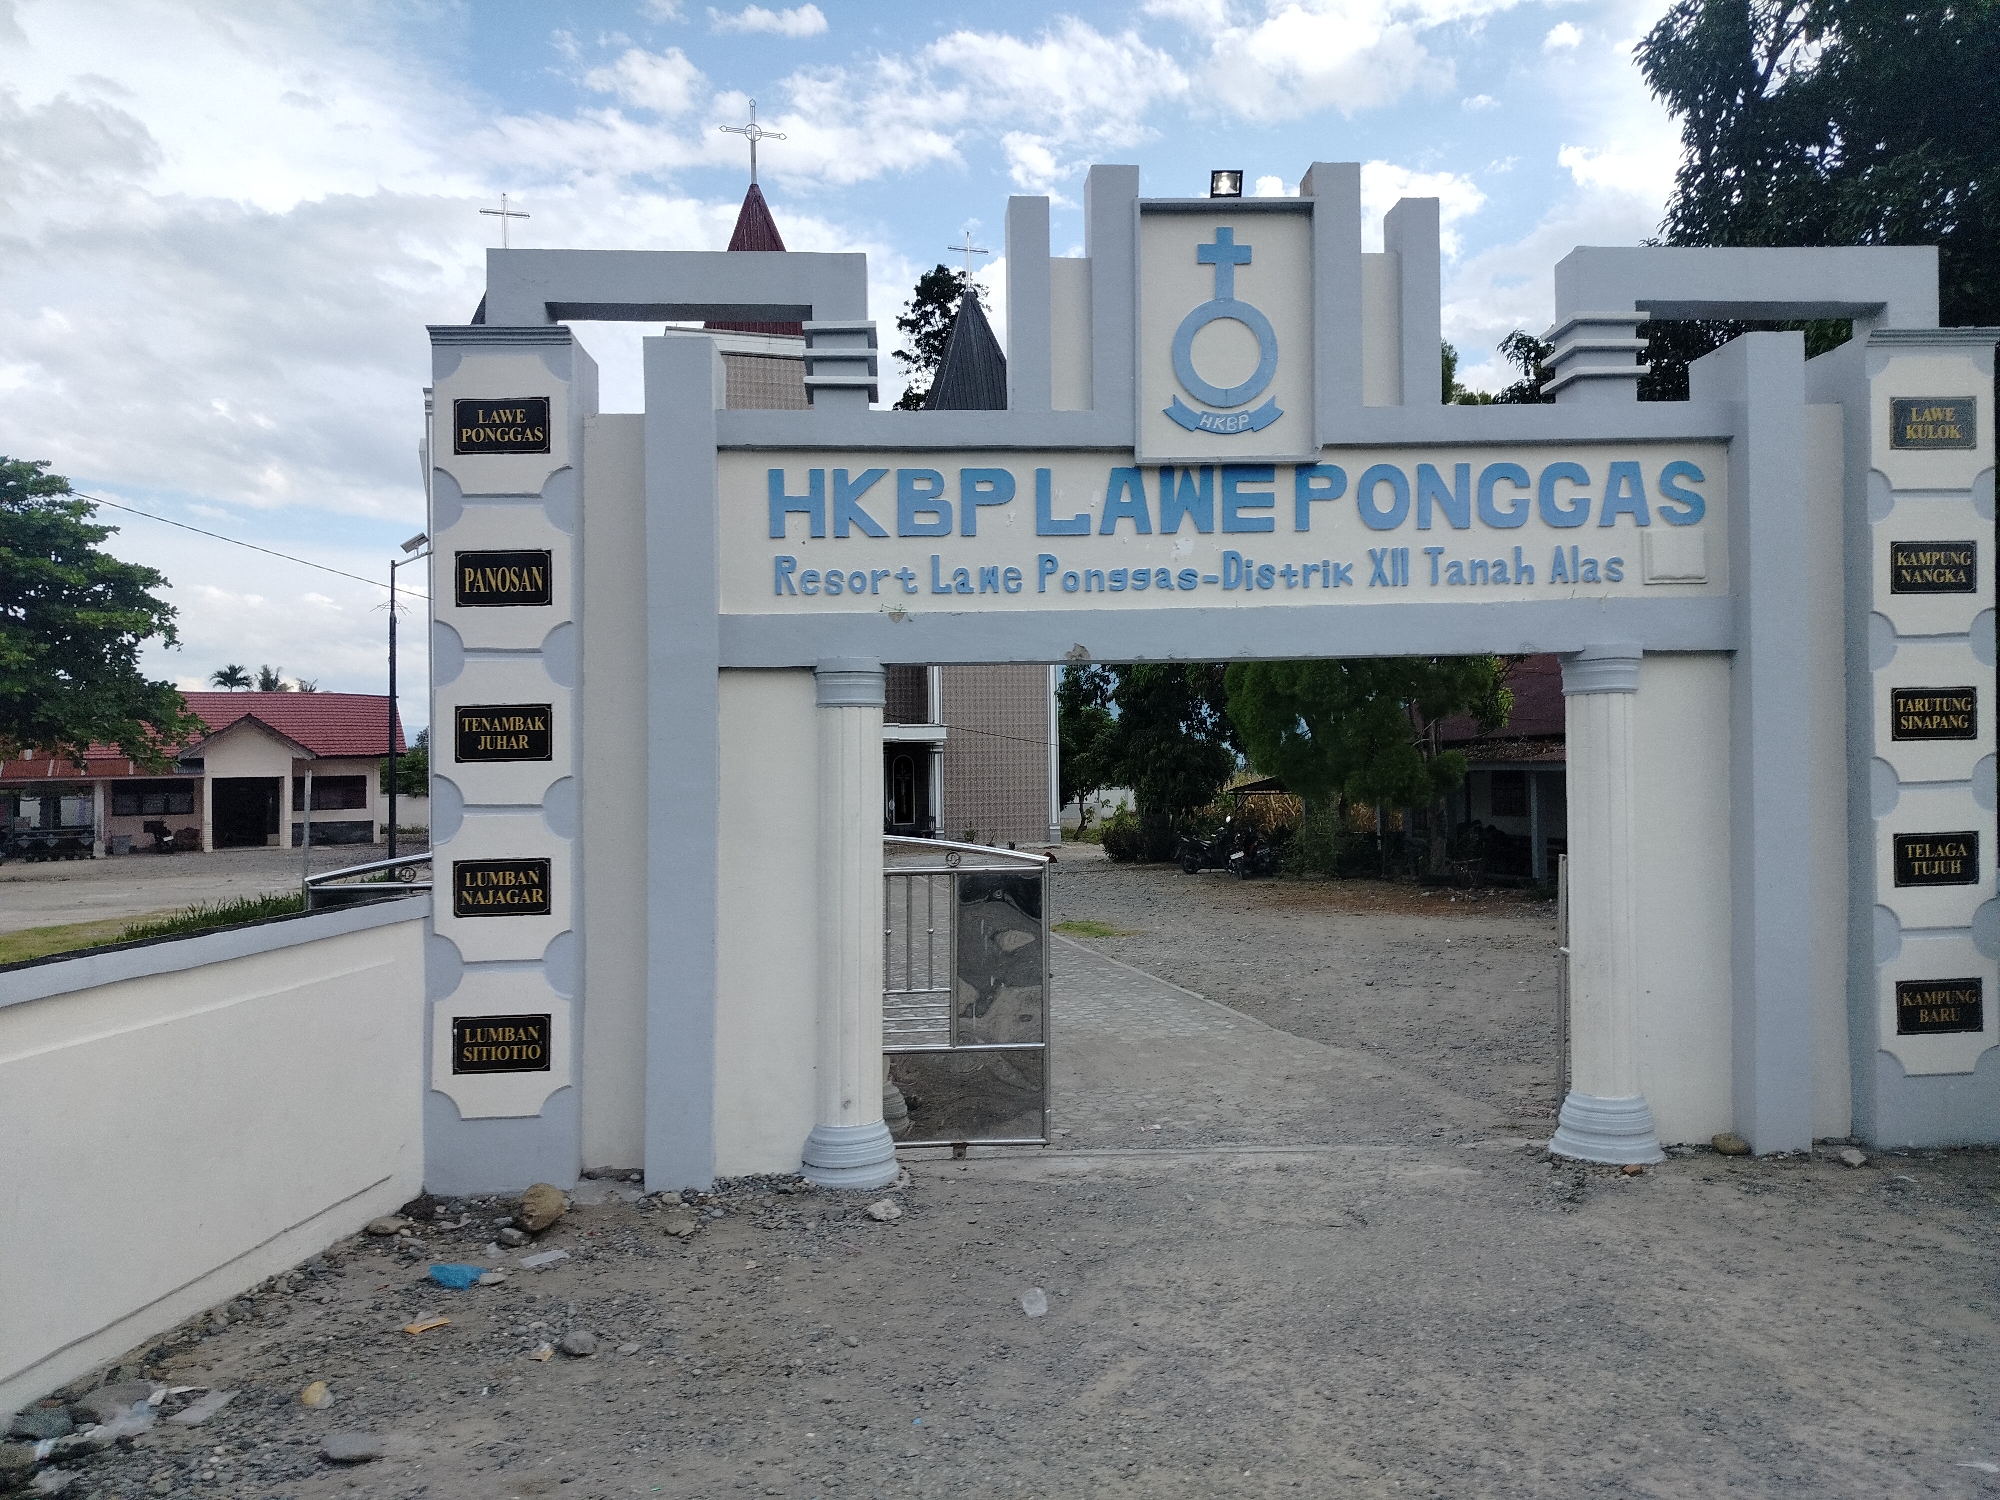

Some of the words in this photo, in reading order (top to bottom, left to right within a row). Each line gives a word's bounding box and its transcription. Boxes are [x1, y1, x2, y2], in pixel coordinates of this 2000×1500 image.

[478, 408, 527, 424] LAWE
[1911, 407, 1956, 422] LAWE
[1199, 414, 1250, 432] HKBP
[461, 426, 544, 443] PONGGAS
[1906, 424, 1962, 440] KULOK
[768, 468, 1017, 538] HKBP
[1035, 465, 1275, 536] LAWE
[1294, 460, 1706, 532] PONGGAS
[1896, 551, 1972, 566] KAMPUNG
[774, 555, 919, 595] Resort
[1369, 546, 1410, 587] XII
[1424, 545, 1536, 587] Tanah
[1550, 545, 1624, 583] Alas
[1900, 568, 1967, 583] NANGKA
[463, 566, 544, 593] PANOSAN
[1896, 697, 1972, 713] TARUTUNG
[462, 715, 546, 732] TENAMBAK
[1900, 715, 1969, 730] SINAPANG
[477, 734, 530, 750] JUHAR
[1905, 842, 1968, 858] TELAGA
[1911, 860, 1962, 875] TUJUH
[465, 869, 540, 887] LUMBAN
[461, 889, 544, 906] NAJAGAR
[1902, 989, 1978, 1006] KAMPUNG
[1919, 1007, 1960, 1023] BARU
[464, 1026, 540, 1043] LUMBAN
[463, 1043, 541, 1061] SITIOTIO
